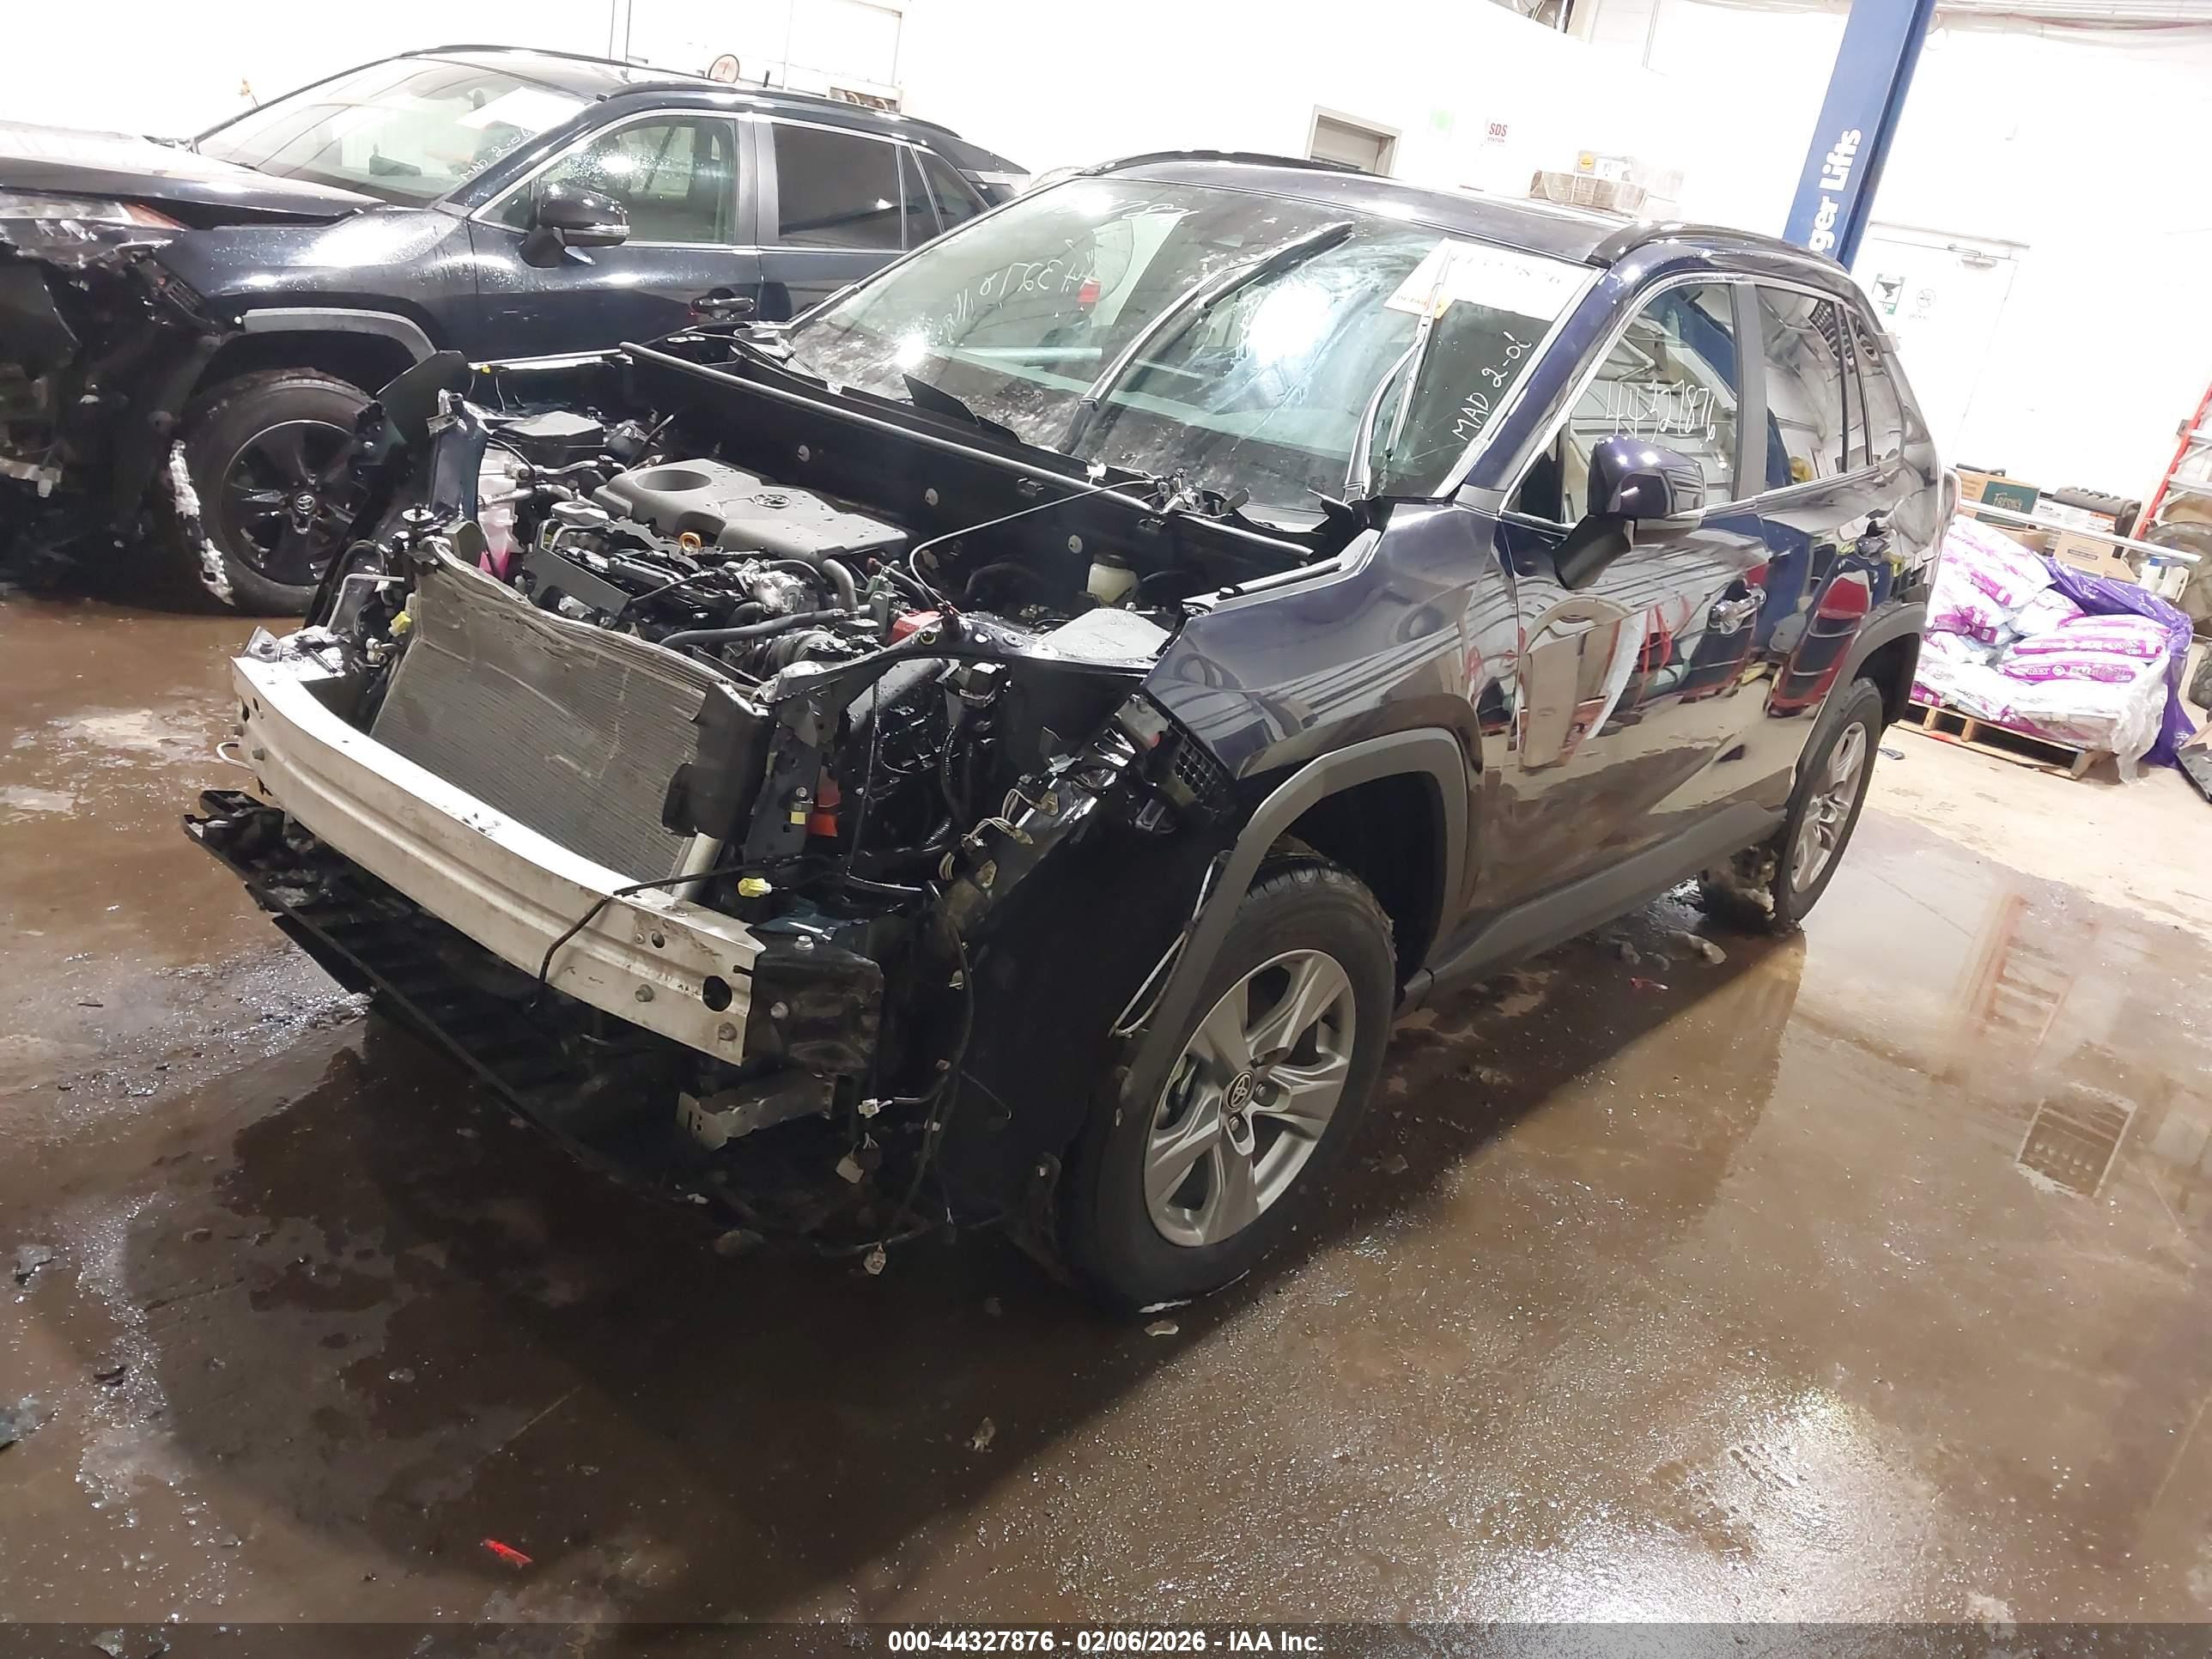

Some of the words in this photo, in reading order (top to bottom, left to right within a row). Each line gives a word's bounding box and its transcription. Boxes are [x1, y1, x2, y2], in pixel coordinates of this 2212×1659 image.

[1488, 123, 1508, 137] SDS
[1819, 129, 1862, 191] Lifts
[1451, 392, 1490, 441] MAD
